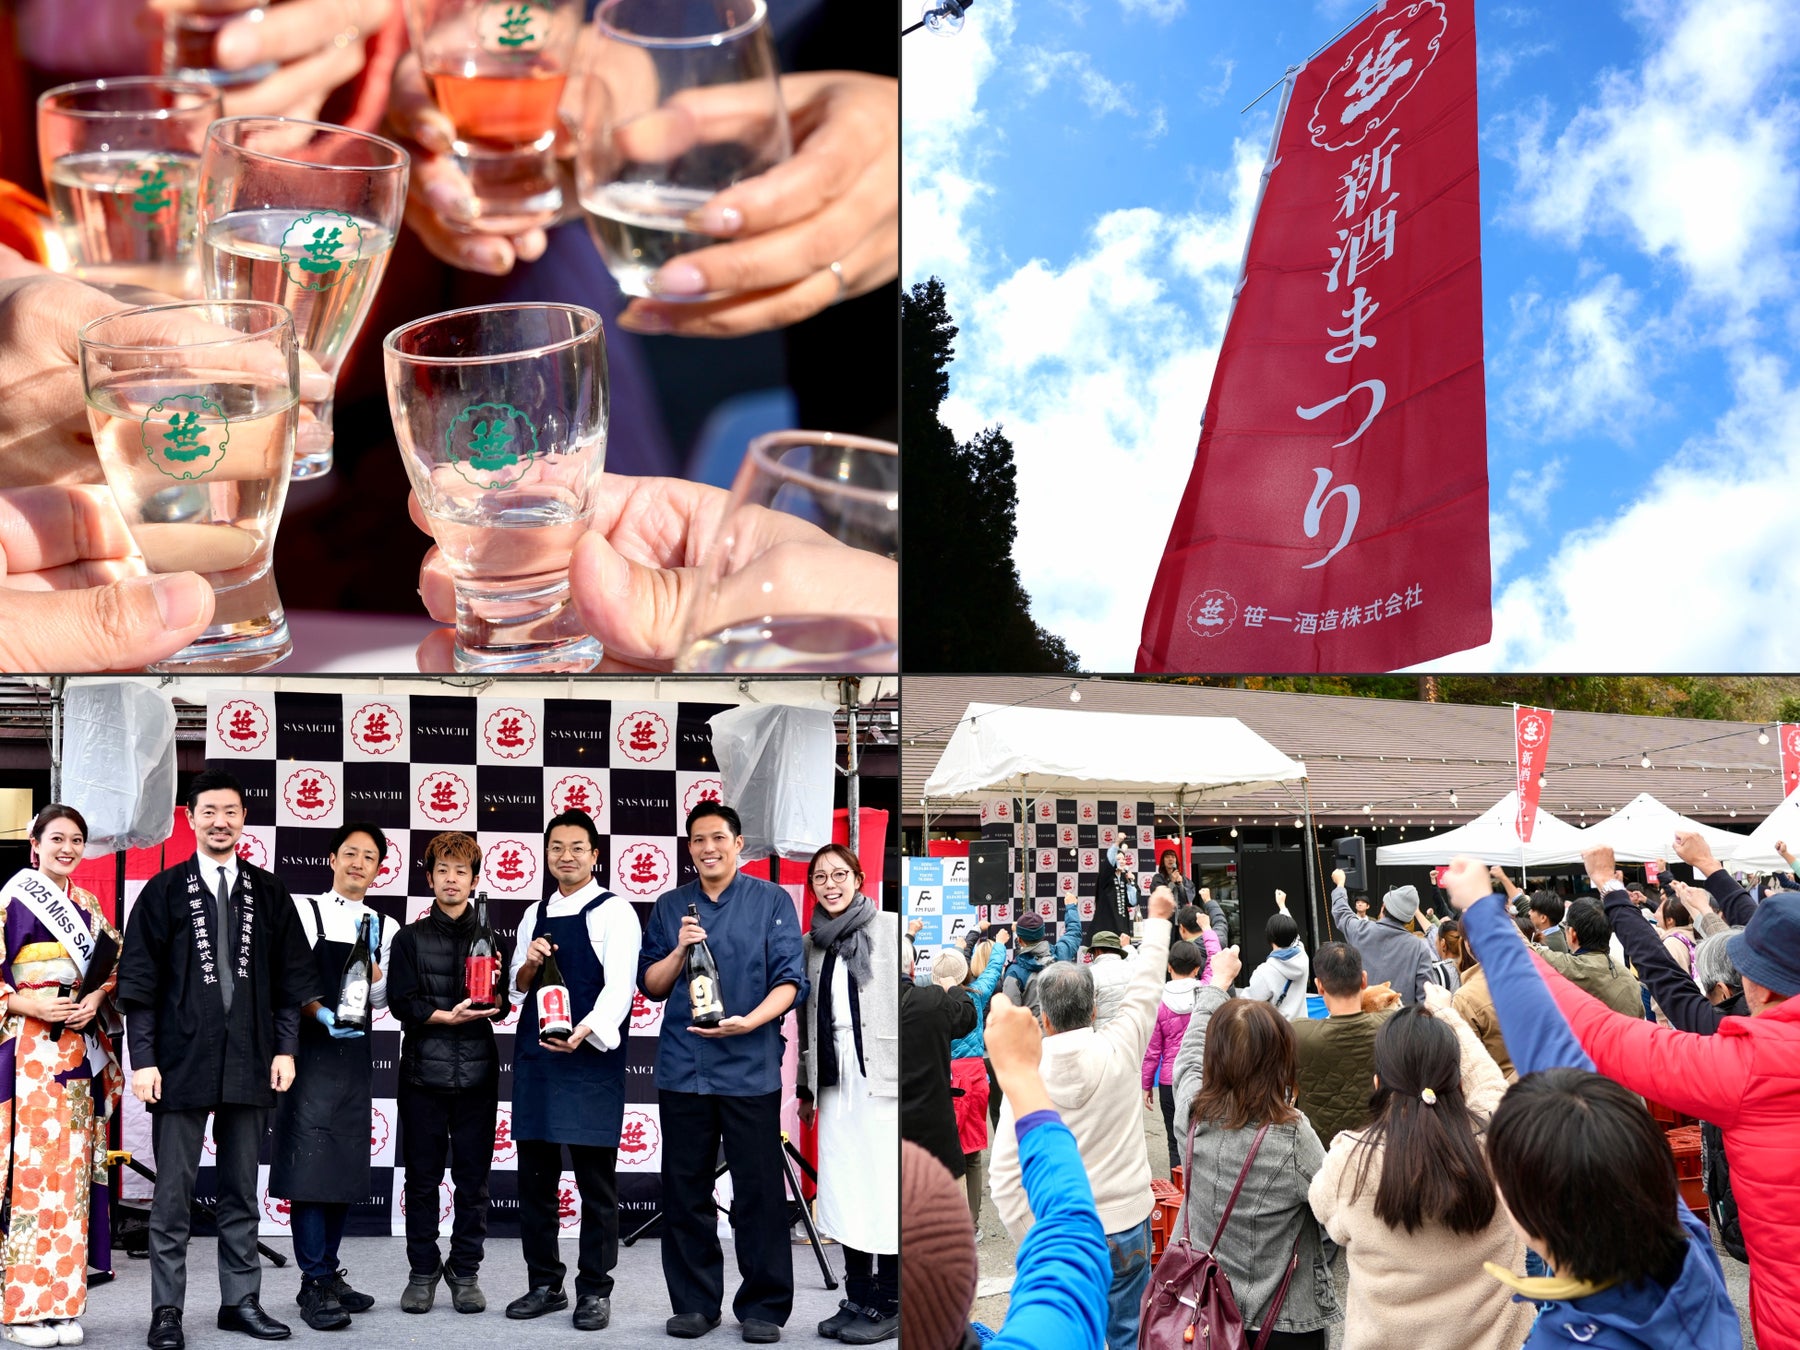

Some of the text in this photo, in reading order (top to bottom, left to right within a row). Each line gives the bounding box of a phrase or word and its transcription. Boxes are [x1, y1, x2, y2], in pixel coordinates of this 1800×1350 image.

[1296, 127, 1401, 569] 新酒まつり
[1243, 583, 1423, 635] 笹一酒造株式会社
[283, 723, 335, 733] SASAICHI
[417, 726, 469, 736] SASAICHI
[550, 730, 602, 740] SASAICHI
[350, 791, 402, 800] SASAICHI
[484, 794, 536, 804] SASAICHI
[617, 798, 669, 808] SASAICHI
[17, 877, 93, 962] 2025 Miss SA
